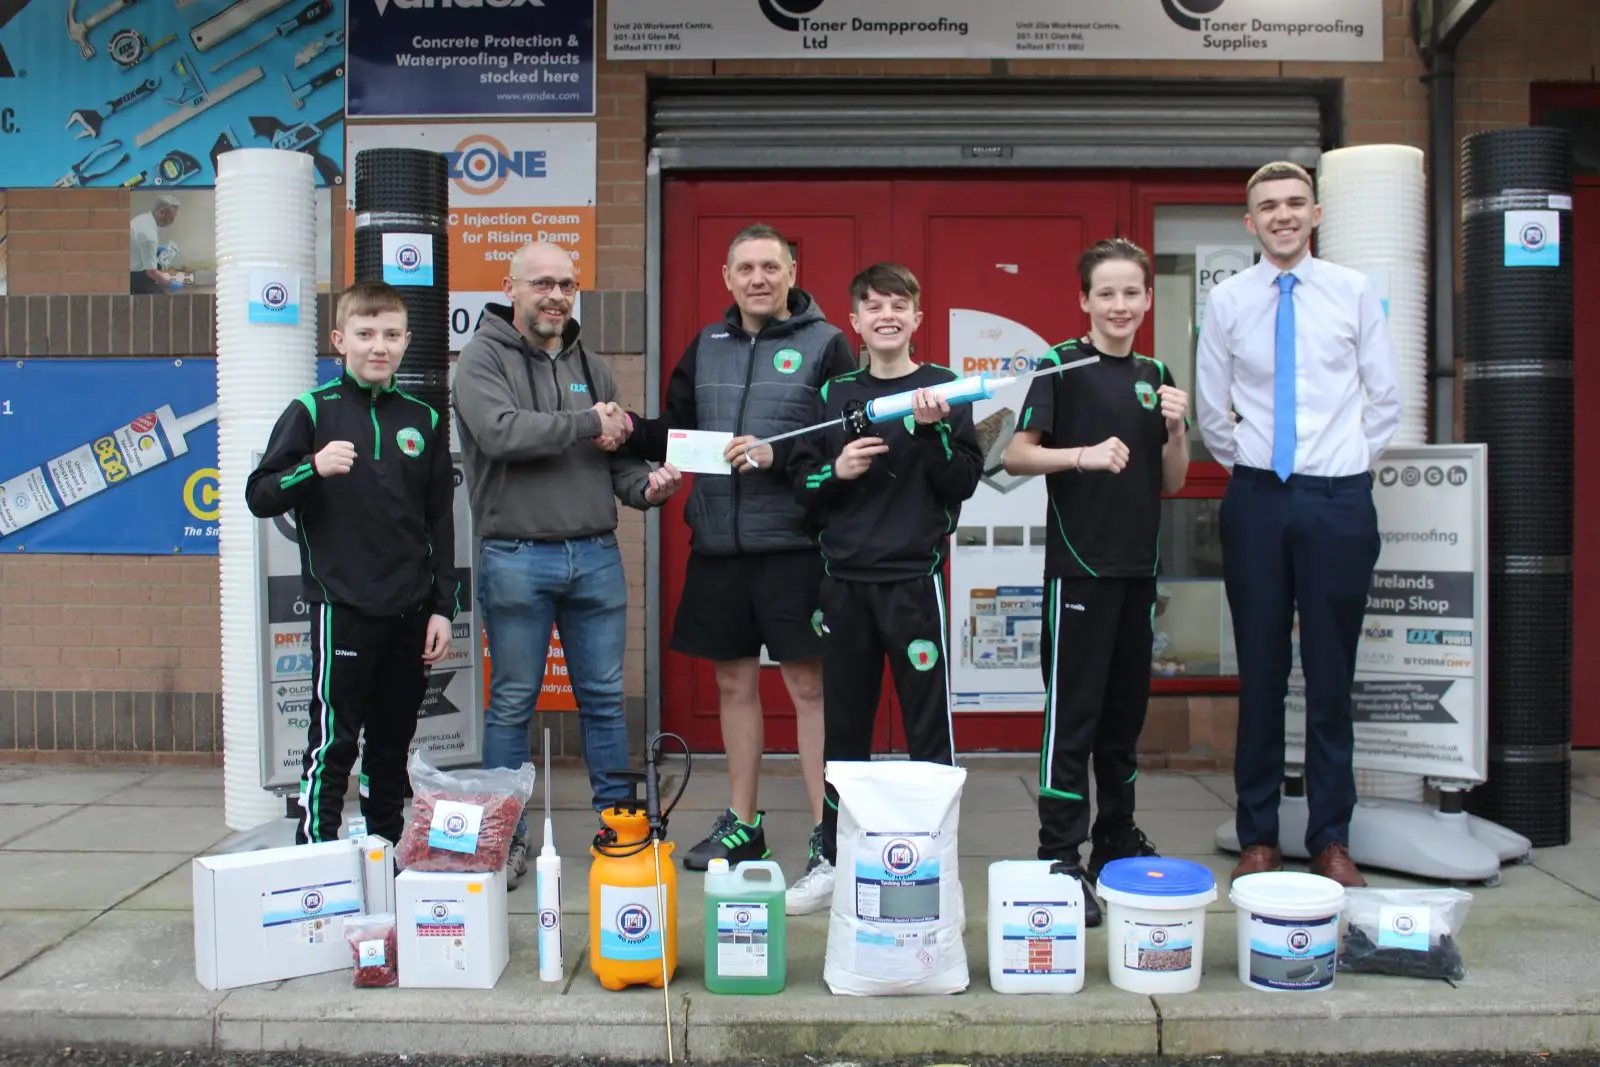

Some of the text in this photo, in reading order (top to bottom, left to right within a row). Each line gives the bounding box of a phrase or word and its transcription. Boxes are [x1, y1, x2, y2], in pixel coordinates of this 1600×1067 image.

[802, 17, 968, 34] Toner Dampproofing
[1203, 18, 1364, 36] Toner Dampproofing
[412, 34, 579, 49] Concrete Protection &
[803, 35, 827, 49] Ltd
[1203, 35, 1268, 51] Supplies
[396, 52, 580, 69] Waterproofing Products
[480, 69, 579, 84] stocked here
[497, 91, 579, 100] www.vandex.com
[463, 213, 527, 226] Injection
[531, 212, 580, 225] Cream
[462, 229, 580, 245] for Rising Damp
[184, 526, 203, 536] The
[1374, 574, 1435, 590] Irelands
[1408, 595, 1450, 614] Shop
